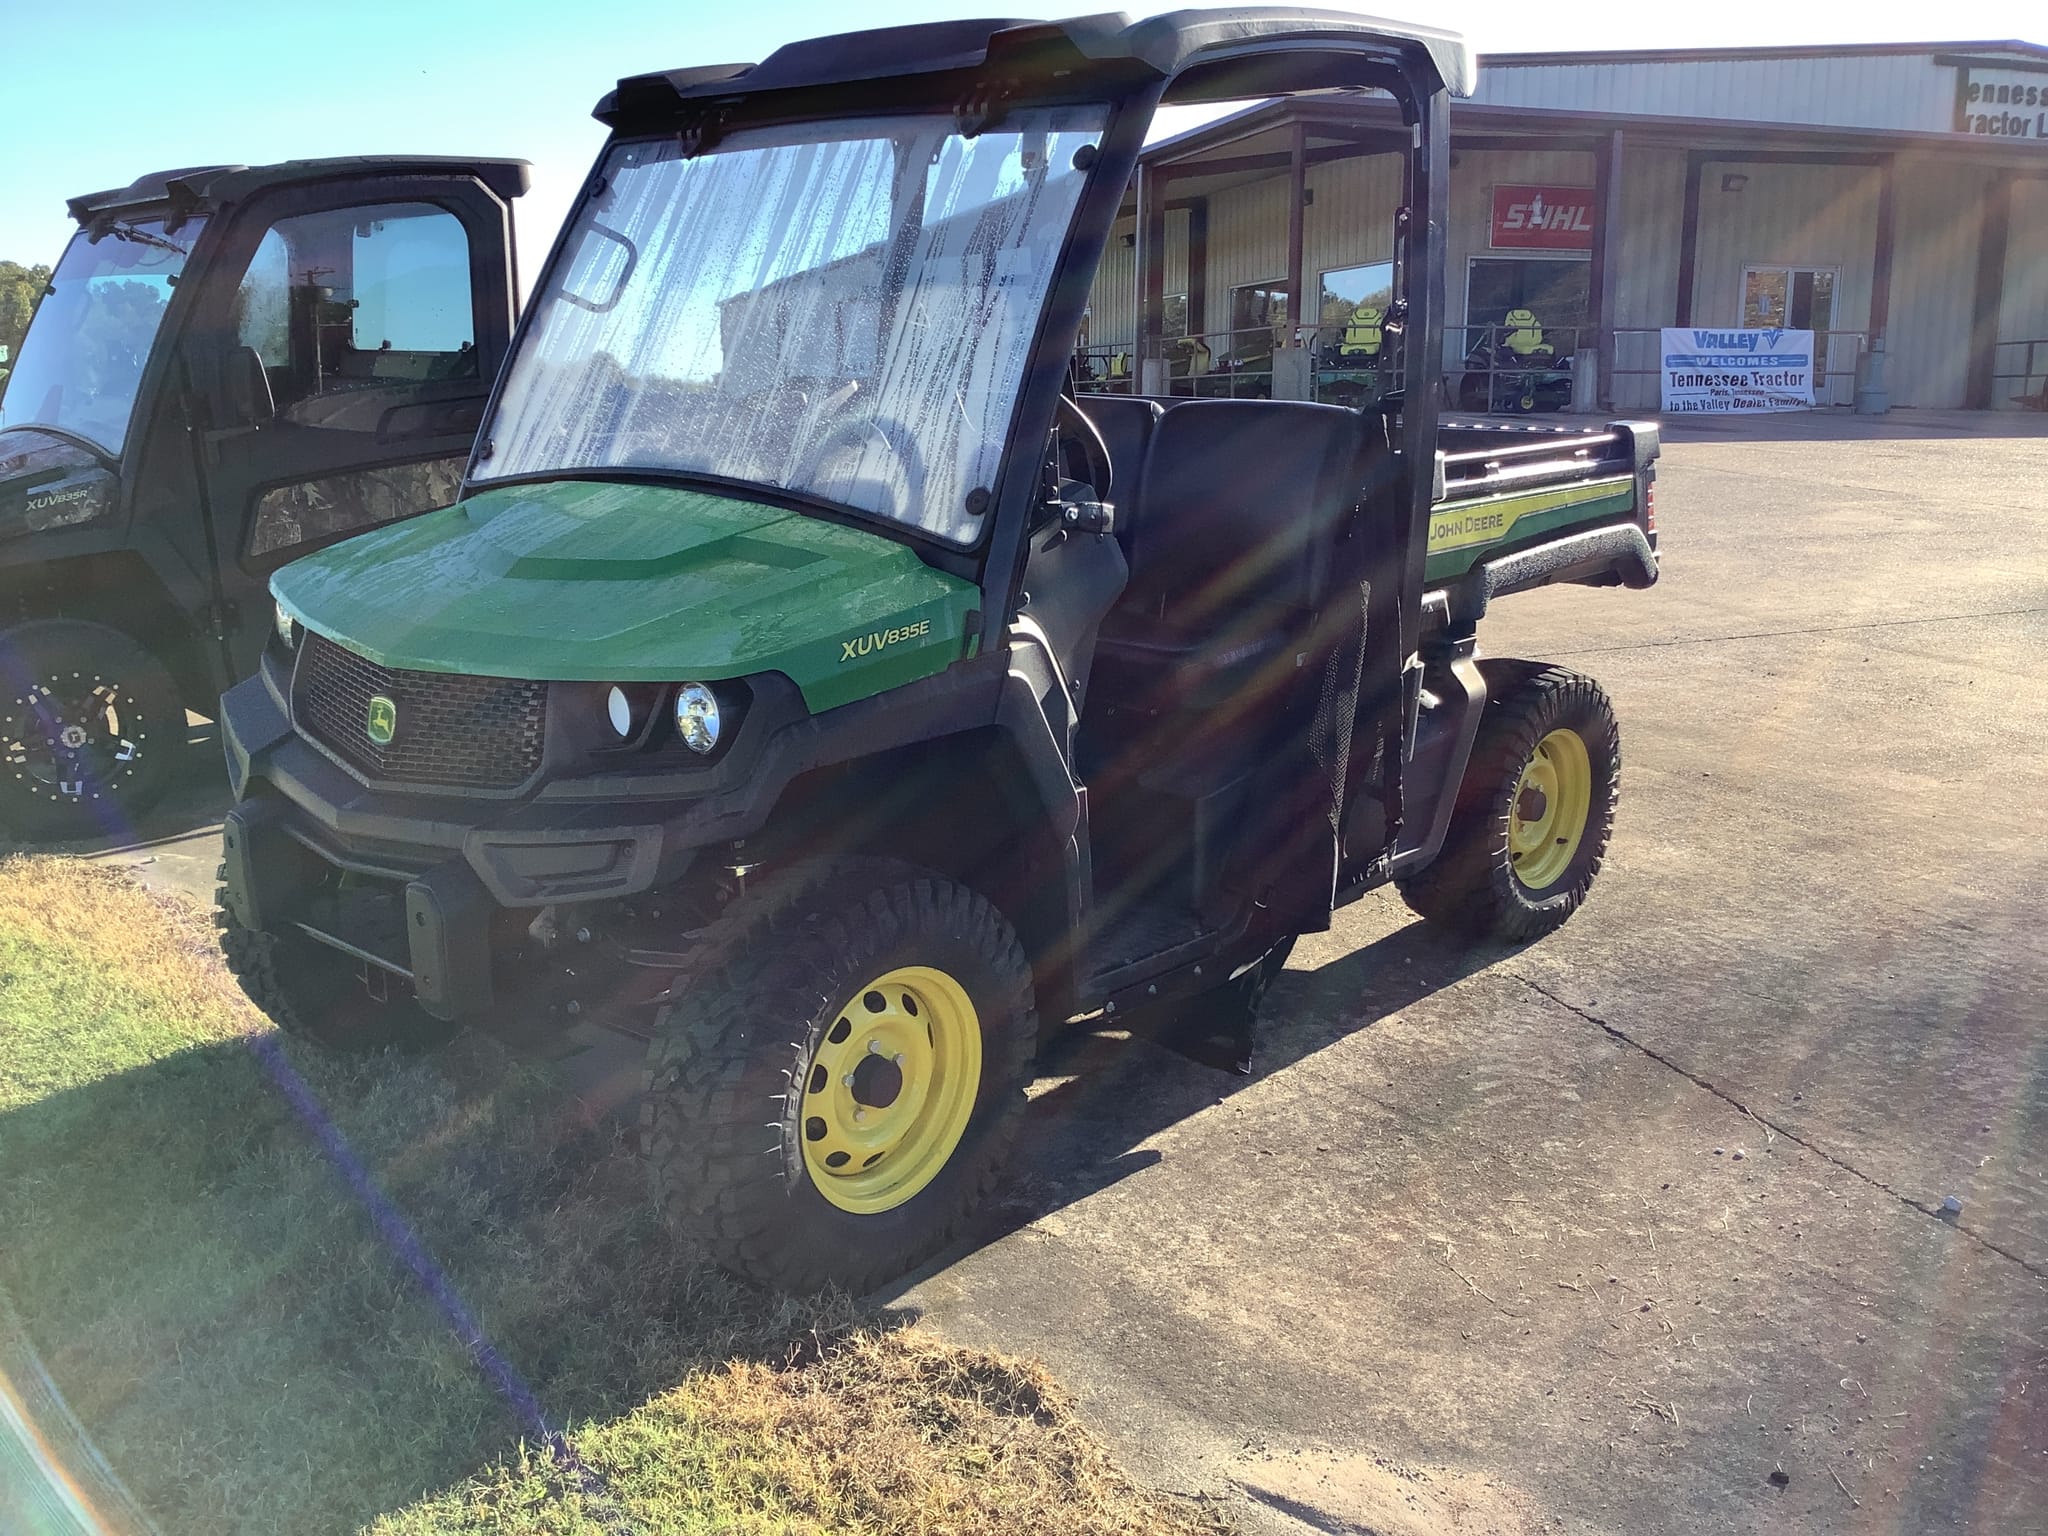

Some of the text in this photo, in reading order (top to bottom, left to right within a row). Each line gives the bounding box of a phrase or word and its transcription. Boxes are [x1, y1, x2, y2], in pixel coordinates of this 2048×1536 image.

[1695, 356, 1779, 367] WELCOMES
[1669, 371, 1805, 388] Tennessee Tractor
[1670, 400, 1680, 412] to
[1682, 399, 1698, 411] the
[1700, 398, 1730, 411] Valley
[1733, 397, 1766, 409] Dealer
[26, 489, 88, 512] XUV835R
[1430, 513, 1504, 541] JOHN DEERE
[840, 620, 930, 662] XUV835E
